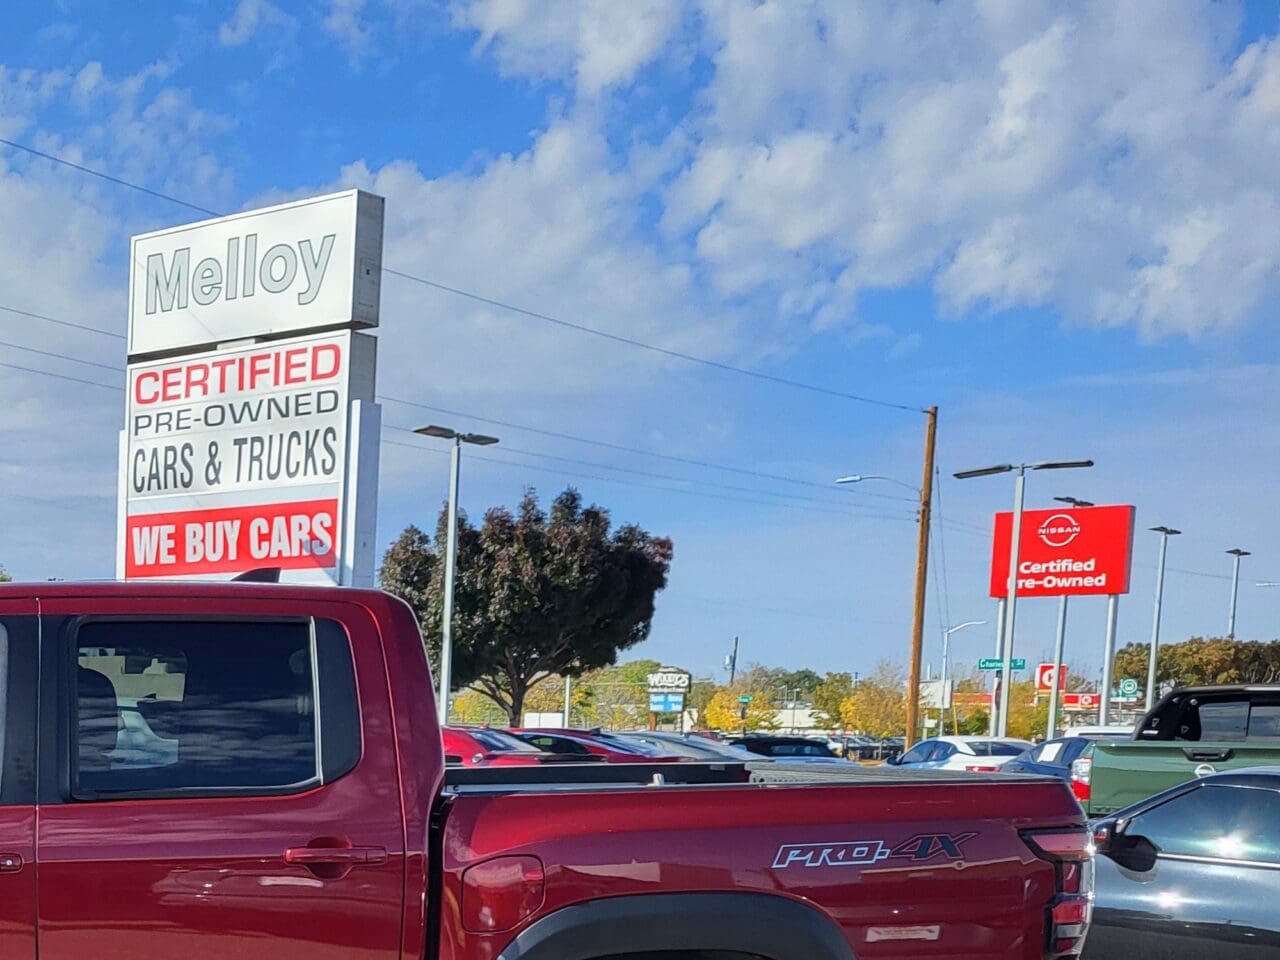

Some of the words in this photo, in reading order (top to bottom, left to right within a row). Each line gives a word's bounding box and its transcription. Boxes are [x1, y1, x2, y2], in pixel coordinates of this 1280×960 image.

[145, 233, 337, 316] Melloy
[134, 343, 342, 405] CERTIFIED
[134, 389, 340, 437] PRE-OWNED
[132, 440, 194, 493] CARS
[204, 440, 222, 486] &
[233, 426, 337, 483] TRUCKS
[131, 522, 177, 566] WE
[184, 518, 242, 564] BUY
[248, 511, 333, 560] CARS
[1038, 526, 1081, 535] NISSAN
[1019, 558, 1096, 574] Certified
